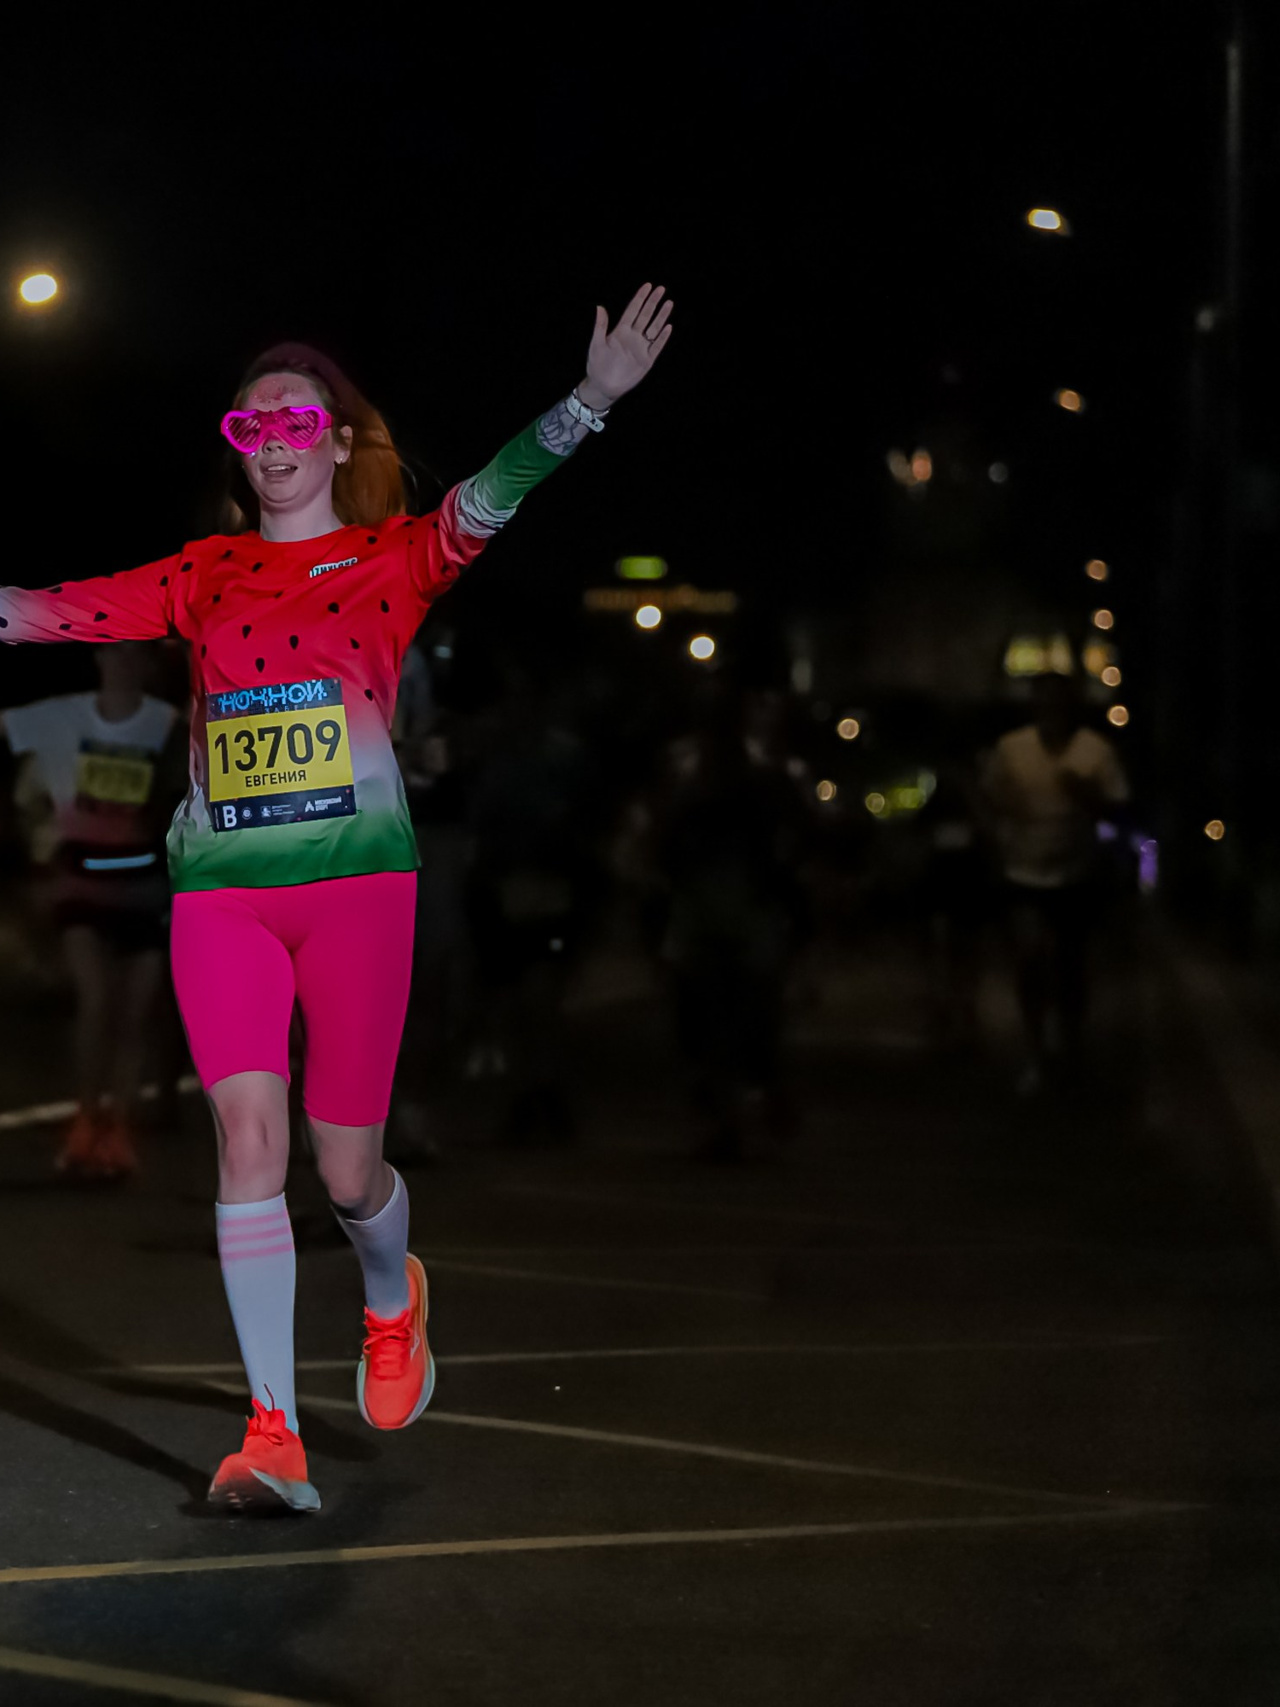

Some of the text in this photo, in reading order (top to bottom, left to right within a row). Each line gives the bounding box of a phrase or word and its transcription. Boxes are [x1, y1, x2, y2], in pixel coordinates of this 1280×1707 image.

[218, 679, 328, 713] НОЧНОЙ
[214, 719, 342, 775] 13709
[245, 769, 307, 788] ЕВГЕНИЯ
